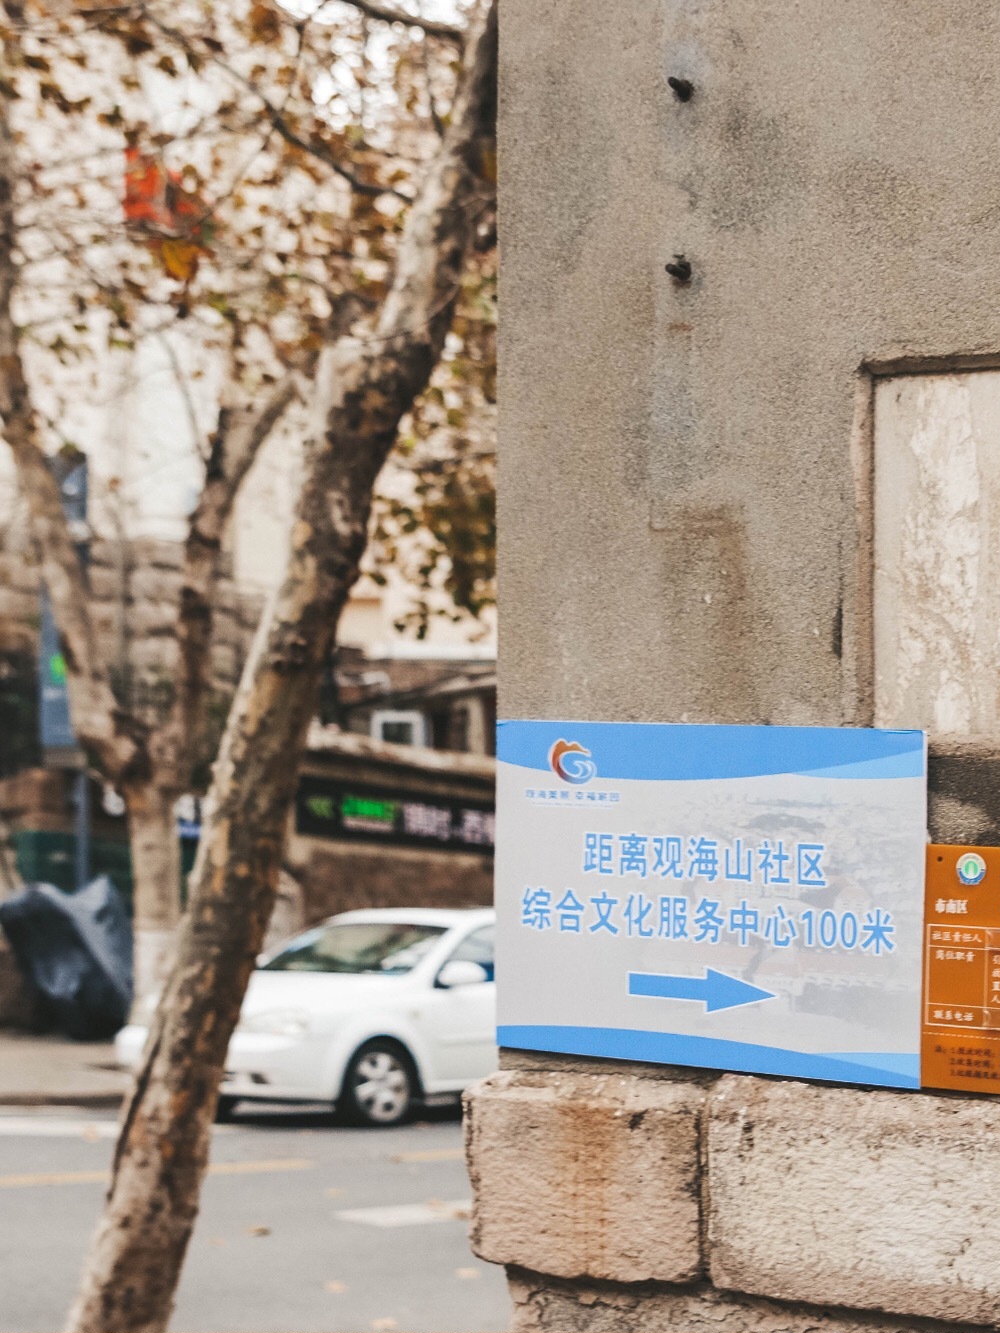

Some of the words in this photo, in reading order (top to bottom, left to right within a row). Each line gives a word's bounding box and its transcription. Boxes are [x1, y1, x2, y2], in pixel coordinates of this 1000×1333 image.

[583, 832, 827, 888] 距离观海山社区
[521, 886, 896, 955] 综合文化服务中心100米
[935, 899, 968, 914] 市南区
